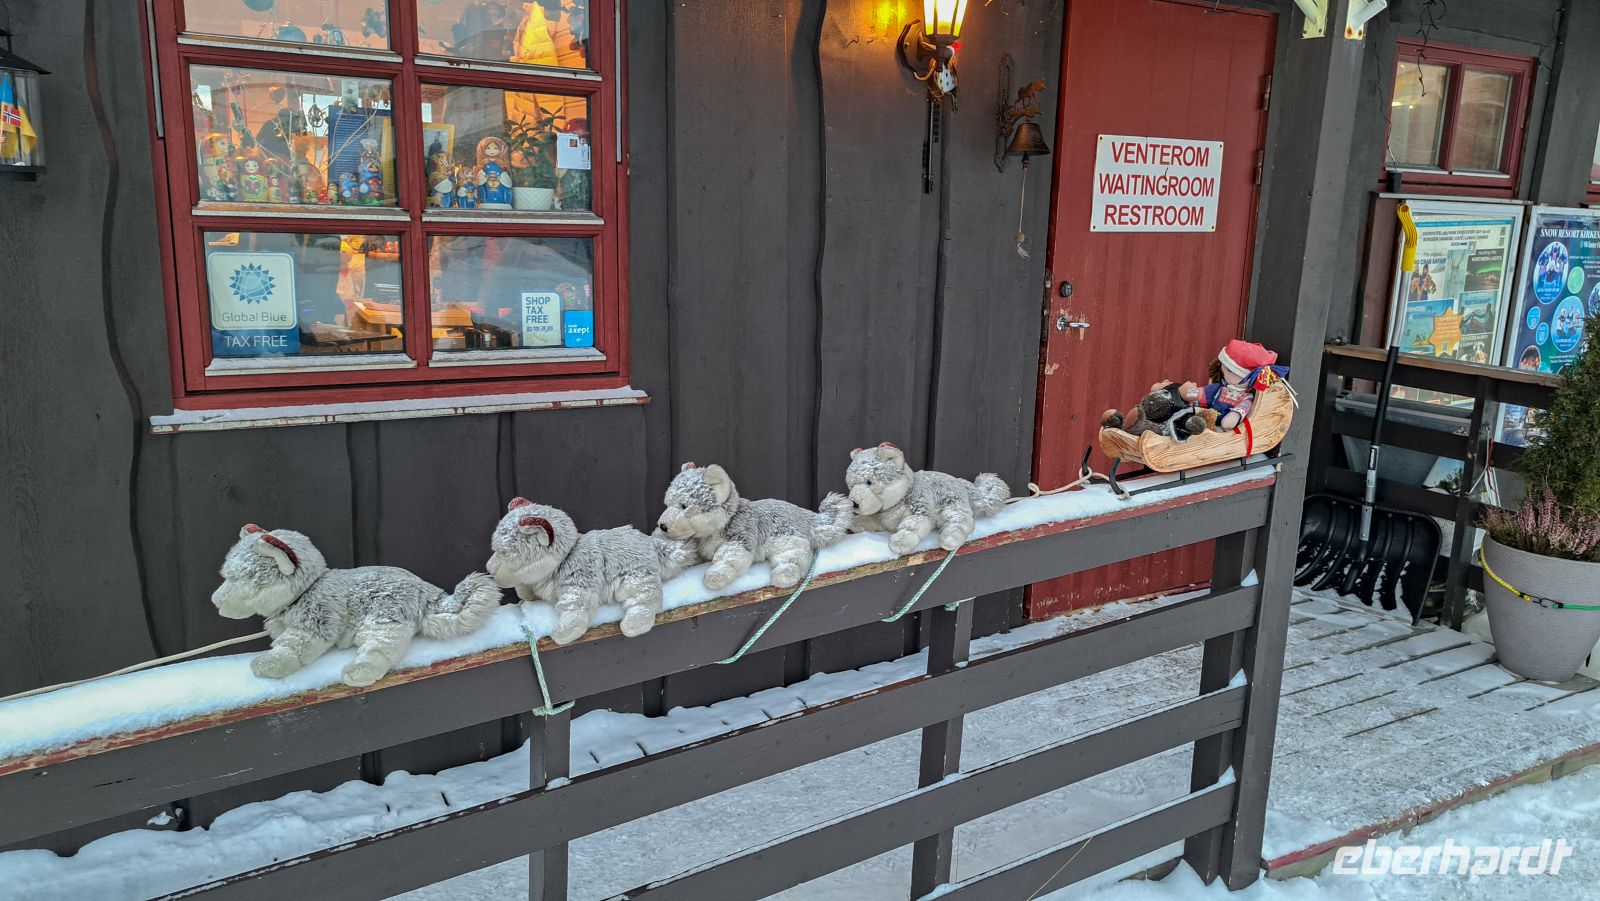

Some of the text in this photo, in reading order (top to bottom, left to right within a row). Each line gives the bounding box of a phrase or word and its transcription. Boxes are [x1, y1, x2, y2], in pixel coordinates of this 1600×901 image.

[1111, 141, 1210, 167] VENTEROM
[1099, 172, 1215, 197] WAITINGROOM
[1104, 204, 1205, 226] RESTROOM
[1540, 229, 1559, 238] SNOW
[1558, 229, 1580, 238] RESORT
[525, 296, 551, 305] SHOP
[526, 305, 544, 315] TAX
[222, 312, 287, 322] Global Blue
[526, 315, 549, 324] FREE
[568, 326, 590, 335] axept
[224, 335, 289, 347] TAX FREE
